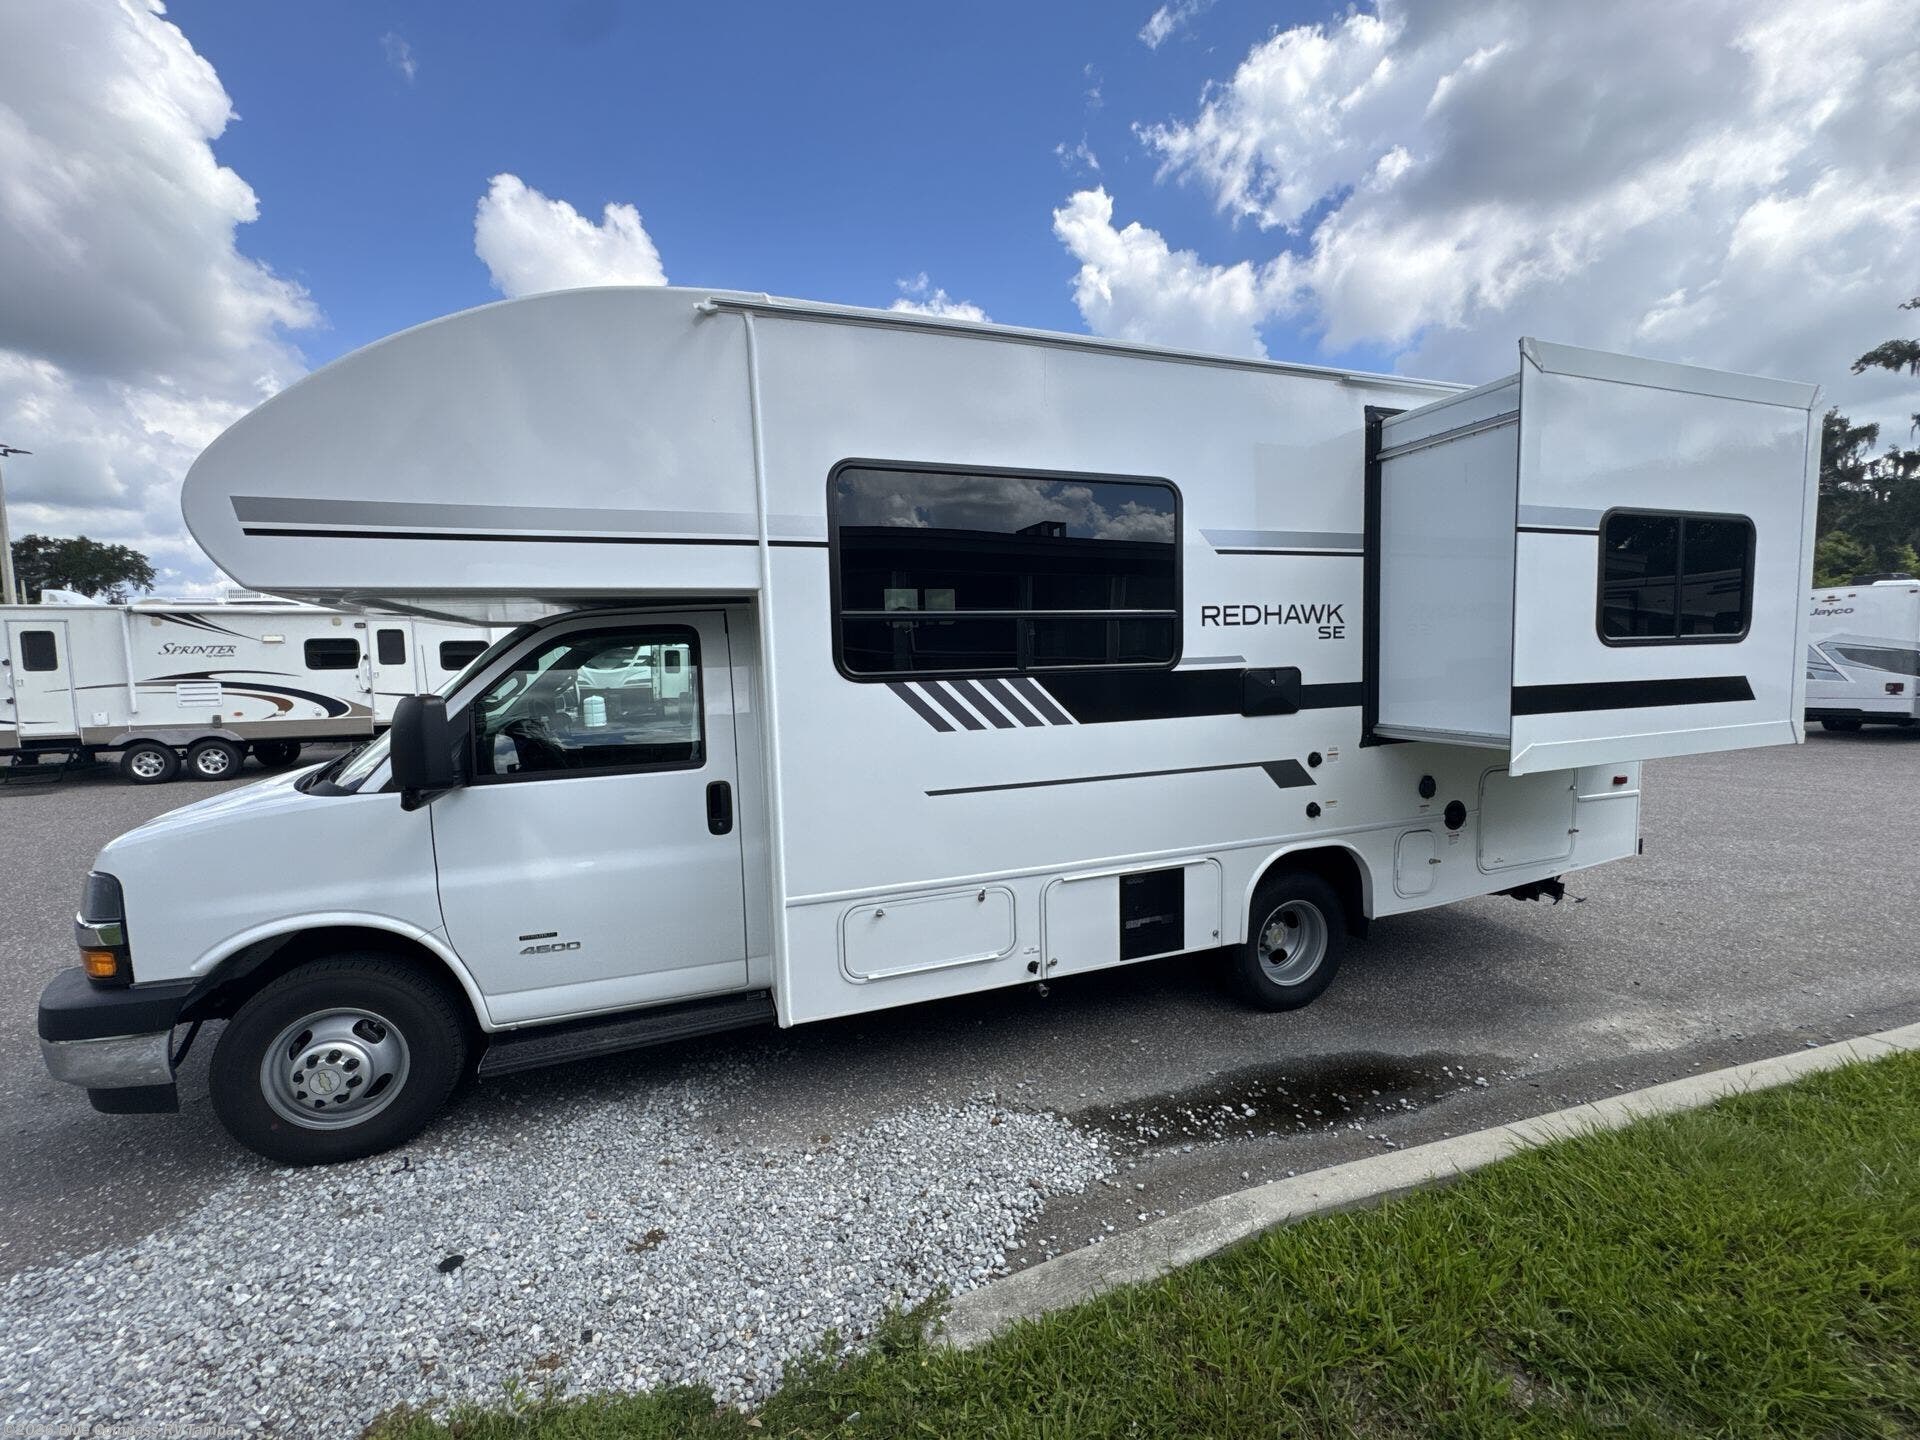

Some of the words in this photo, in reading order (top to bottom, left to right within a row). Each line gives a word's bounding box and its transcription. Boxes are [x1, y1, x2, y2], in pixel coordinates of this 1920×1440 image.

[1201, 603, 1345, 627] REDHAWK
[1809, 607, 1855, 617] Jayco
[1317, 625, 1346, 640] SE
[157, 642, 237, 655] SPRINTER
